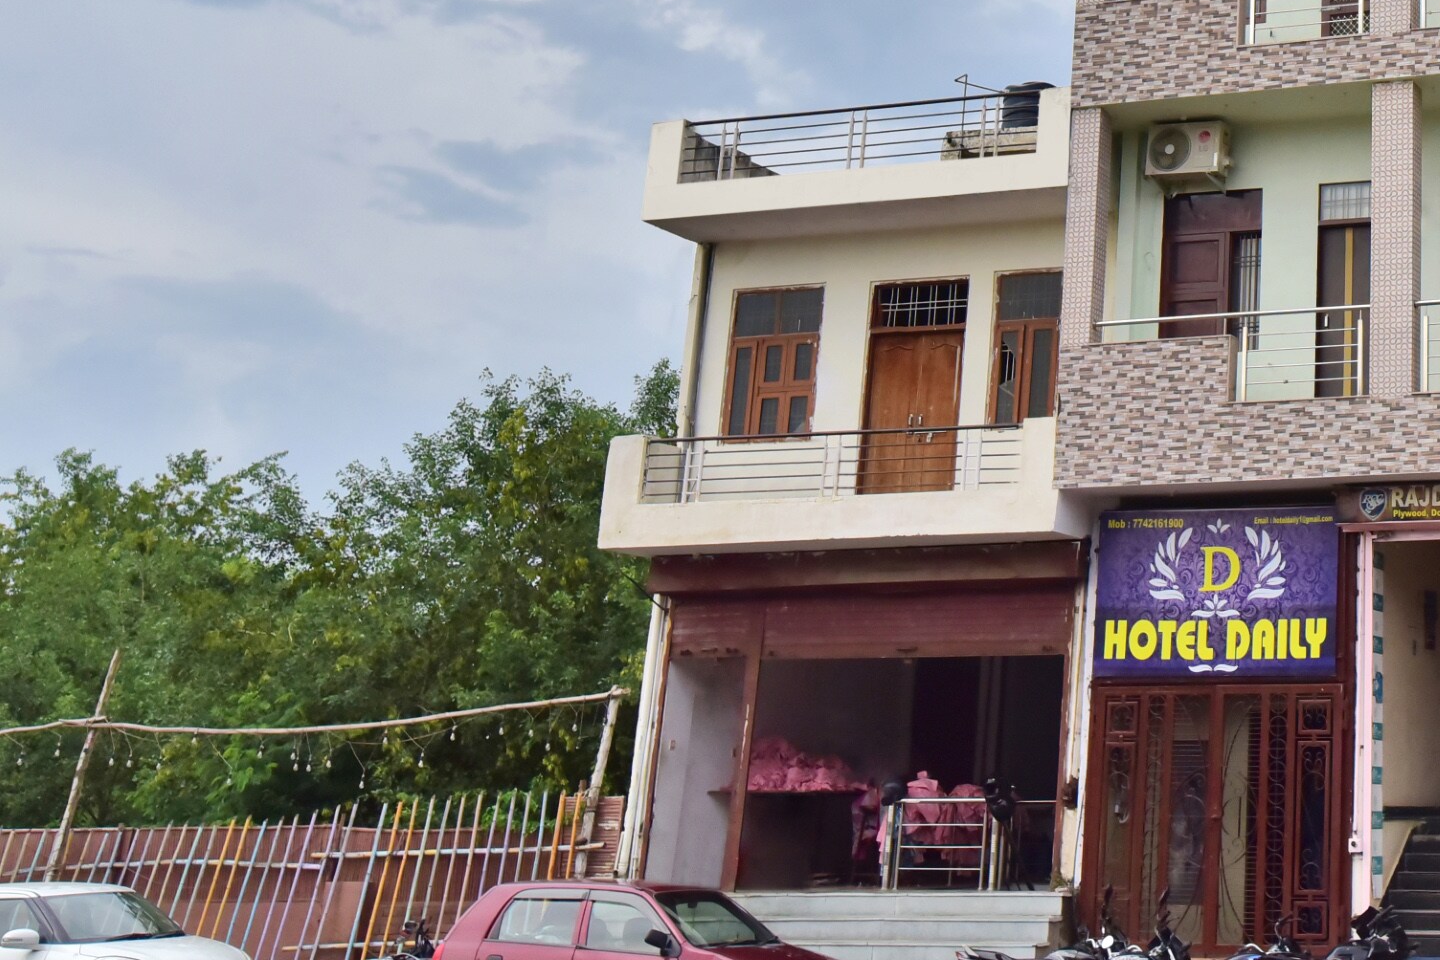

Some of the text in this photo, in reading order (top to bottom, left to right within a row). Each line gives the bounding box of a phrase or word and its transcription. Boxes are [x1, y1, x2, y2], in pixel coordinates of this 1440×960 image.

[1393, 509, 1429, 519] Plywood,
[1107, 519, 1126, 529] Mob
[1132, 518, 1185, 529] 7742161900
[1253, 516, 1269, 525] Email
[1199, 546, 1241, 593] D
[1103, 617, 1328, 661] HOTEL DAILY
